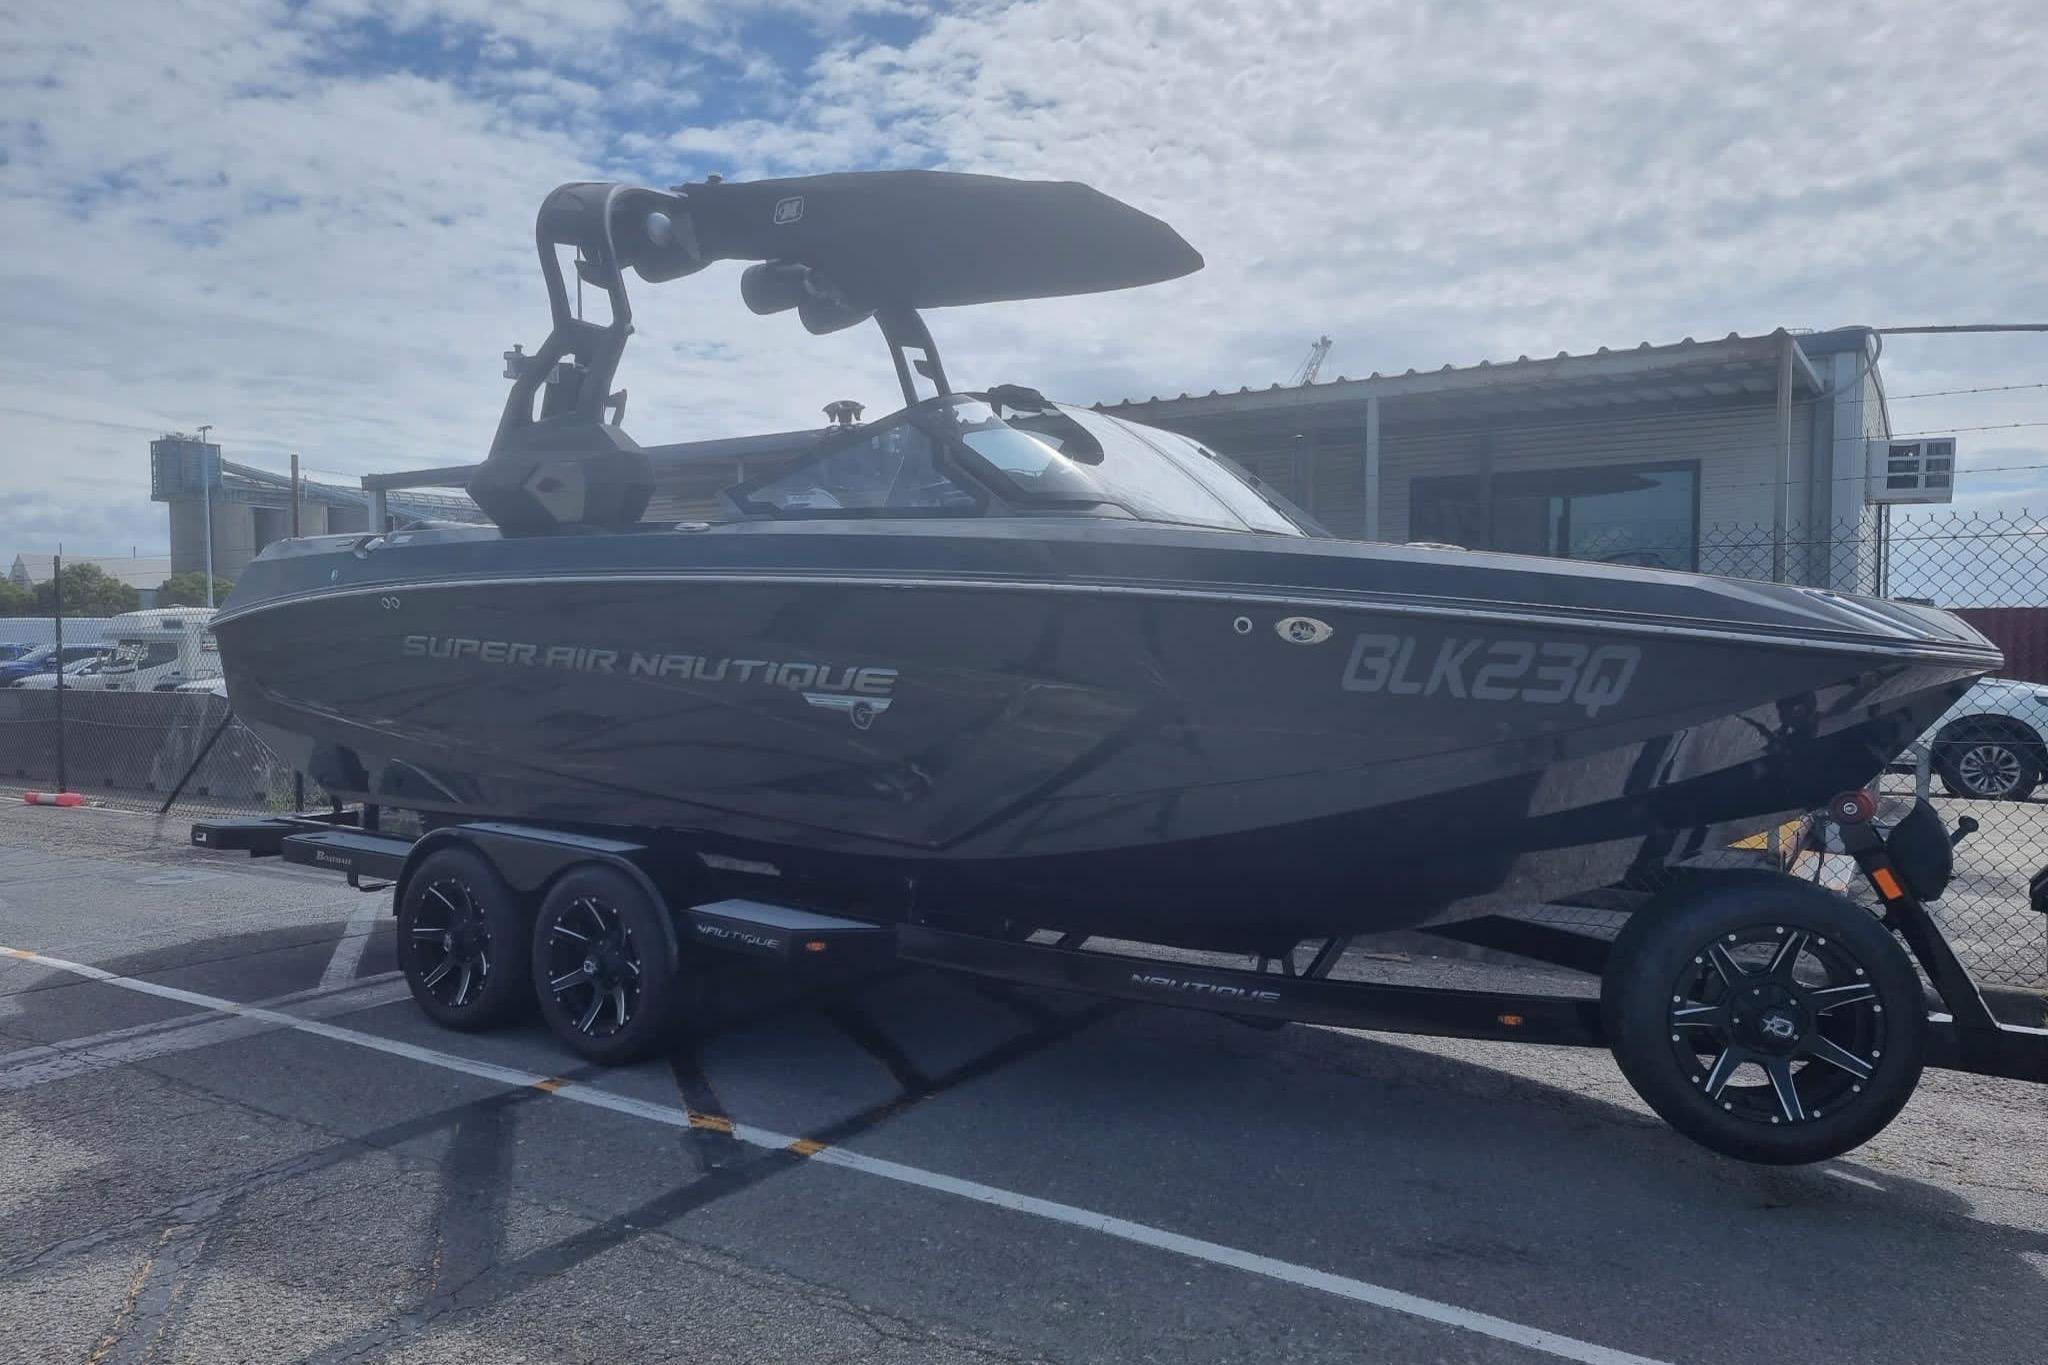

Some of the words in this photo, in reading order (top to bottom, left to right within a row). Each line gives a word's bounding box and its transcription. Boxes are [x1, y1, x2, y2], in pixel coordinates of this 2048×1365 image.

[403, 634, 537, 667] SUPER
[544, 645, 619, 675] AIR
[629, 653, 899, 692] NAUTIQUE
[1341, 633, 1642, 719] BLK23Q
[697, 923, 780, 949] NAUTIQUE
[1131, 973, 1281, 1001] NAUTIQUE
